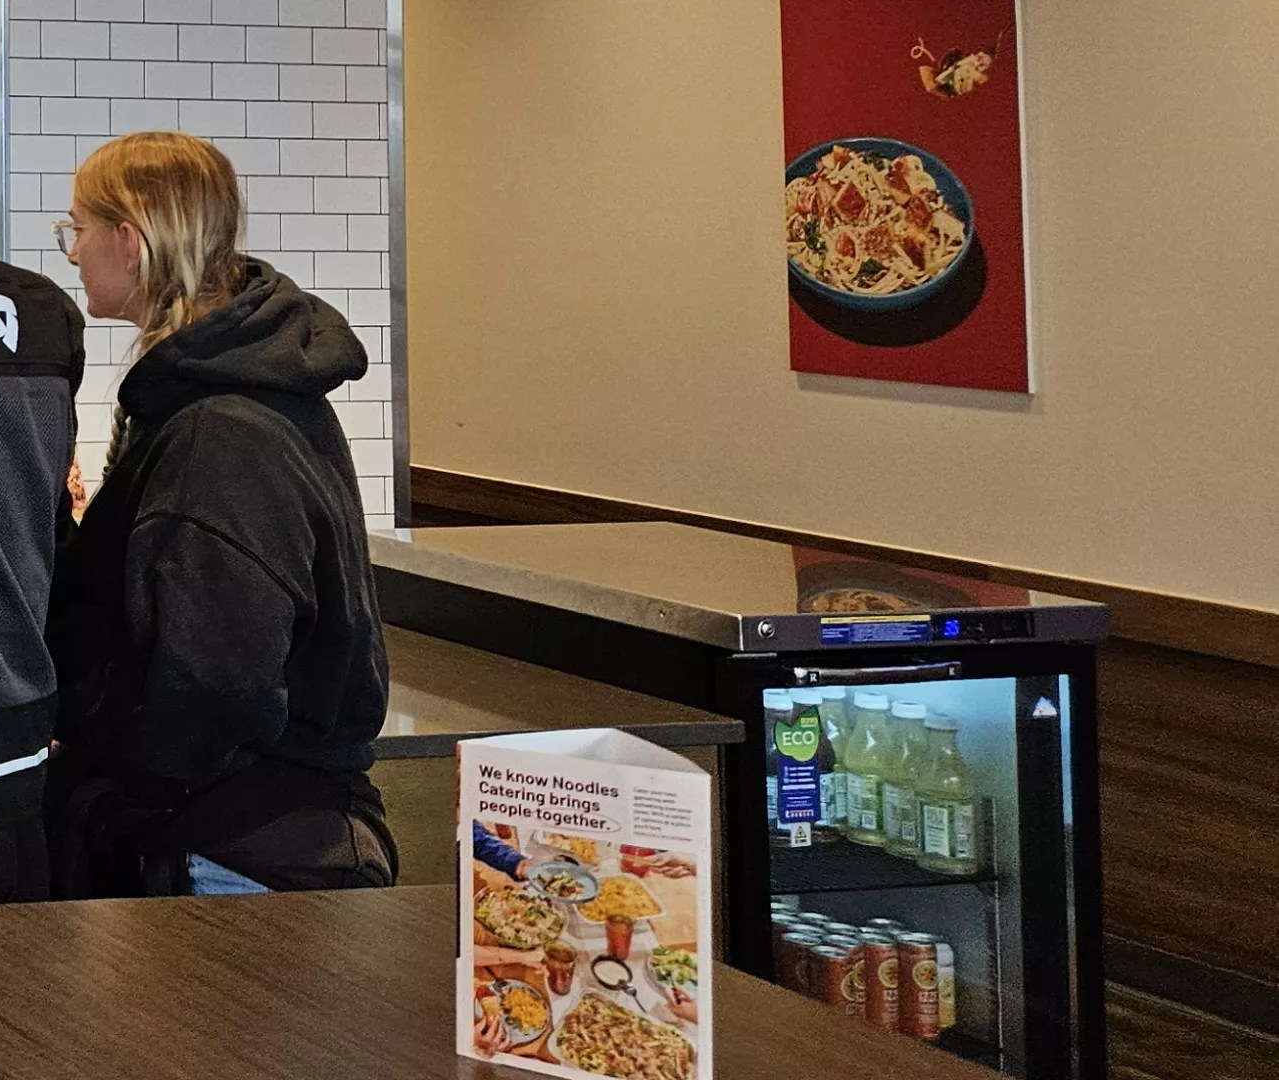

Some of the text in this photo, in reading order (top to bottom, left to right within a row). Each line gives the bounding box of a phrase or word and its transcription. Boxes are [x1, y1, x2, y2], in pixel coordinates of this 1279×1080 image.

[782, 731, 815, 746] ECO
[479, 764, 619, 798] We know Noodles
[479, 781, 600, 813] Catering brings
[479, 800, 610, 830] people together.
